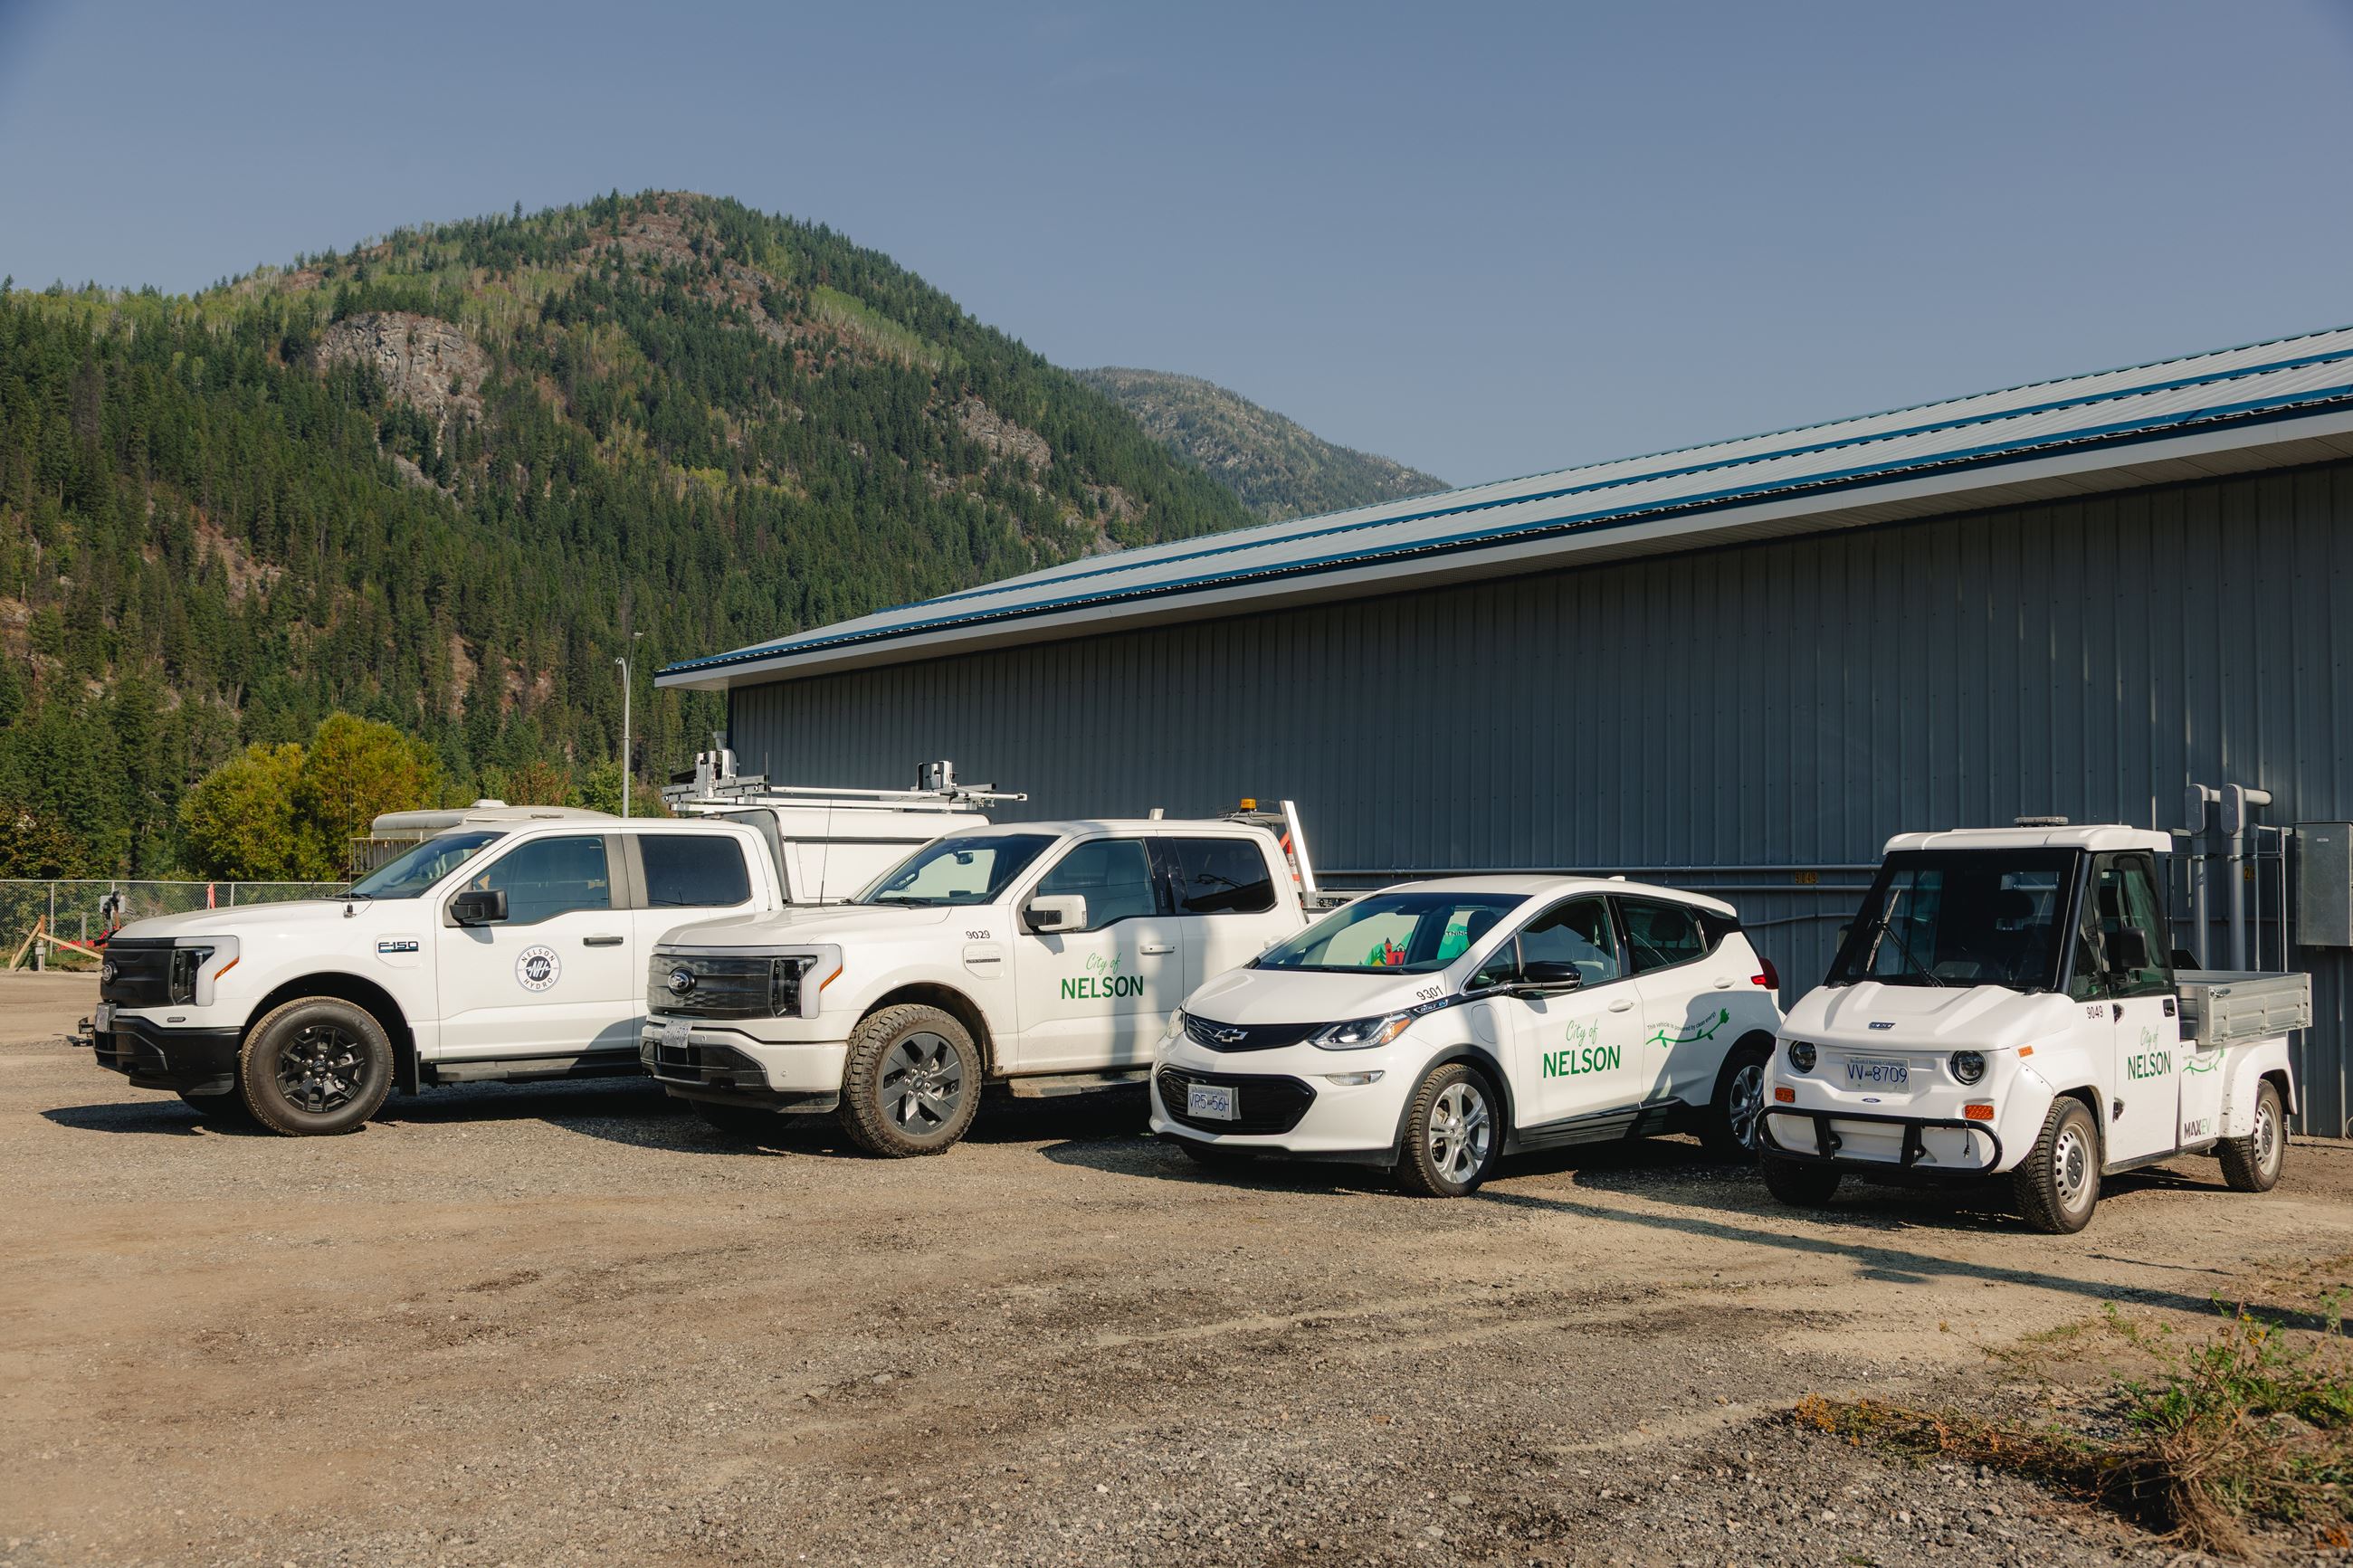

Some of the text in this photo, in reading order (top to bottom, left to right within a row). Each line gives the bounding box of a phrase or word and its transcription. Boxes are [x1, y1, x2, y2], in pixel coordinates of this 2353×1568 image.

[966, 930, 991, 939] 9029
[378, 941, 419, 951] F-150
[521, 948, 555, 963] NELSON
[1086, 952, 1121, 975] City of
[524, 977, 553, 989] HYDRO
[1062, 975, 1143, 1000] NELSON
[1416, 985, 1443, 1001] 9301
[1695, 1020, 1705, 1029] clean
[1705, 1012, 1717, 1023] energy
[2086, 1005, 2103, 1020] 9049
[1566, 1018, 1598, 1047] City of
[2140, 1026, 2152, 1051] City
[1543, 1045, 1621, 1079] NELSON
[2128, 1050, 2171, 1080] NELSON
